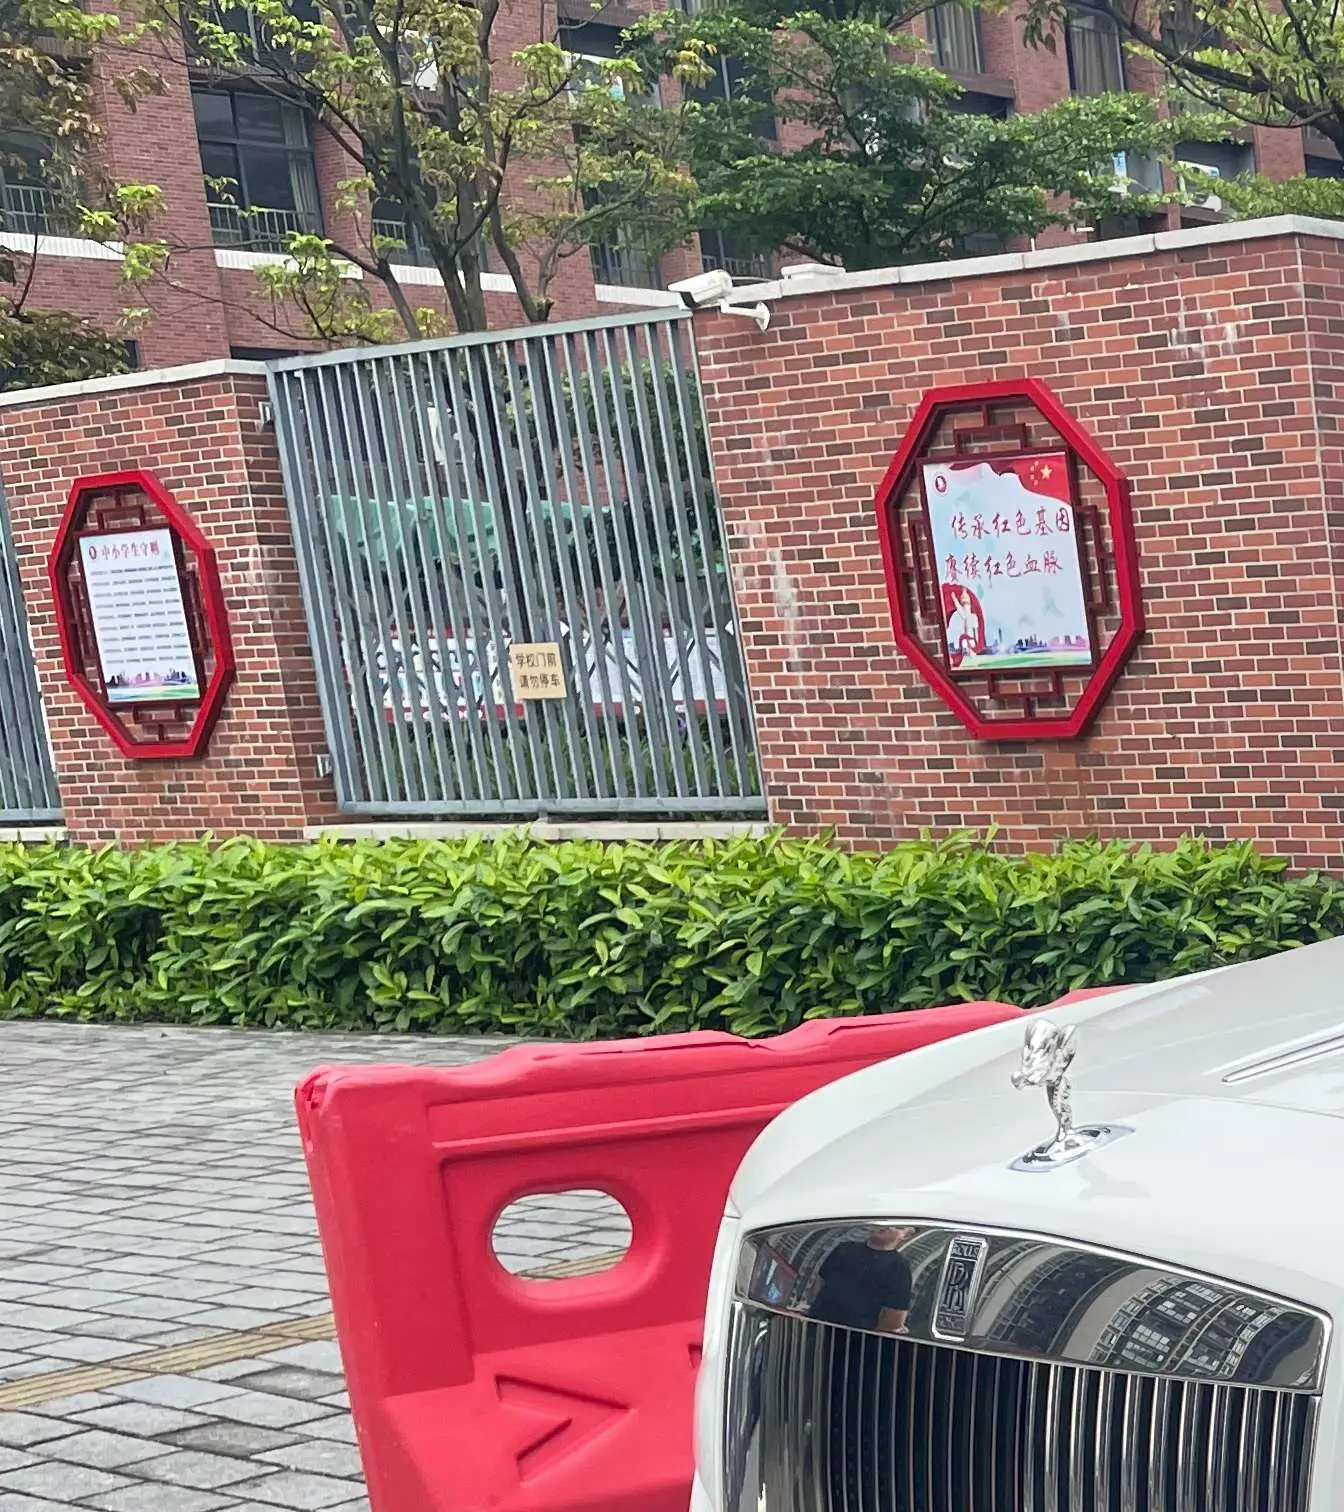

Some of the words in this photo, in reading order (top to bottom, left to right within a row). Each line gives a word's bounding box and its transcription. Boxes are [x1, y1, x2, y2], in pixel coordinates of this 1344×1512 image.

[951, 506, 1070, 540] 传承红色基因
[102, 540, 159, 560] 中小学生守则
[515, 653, 557, 668] 学校门前
[520, 673, 560, 688] 请勿停车
